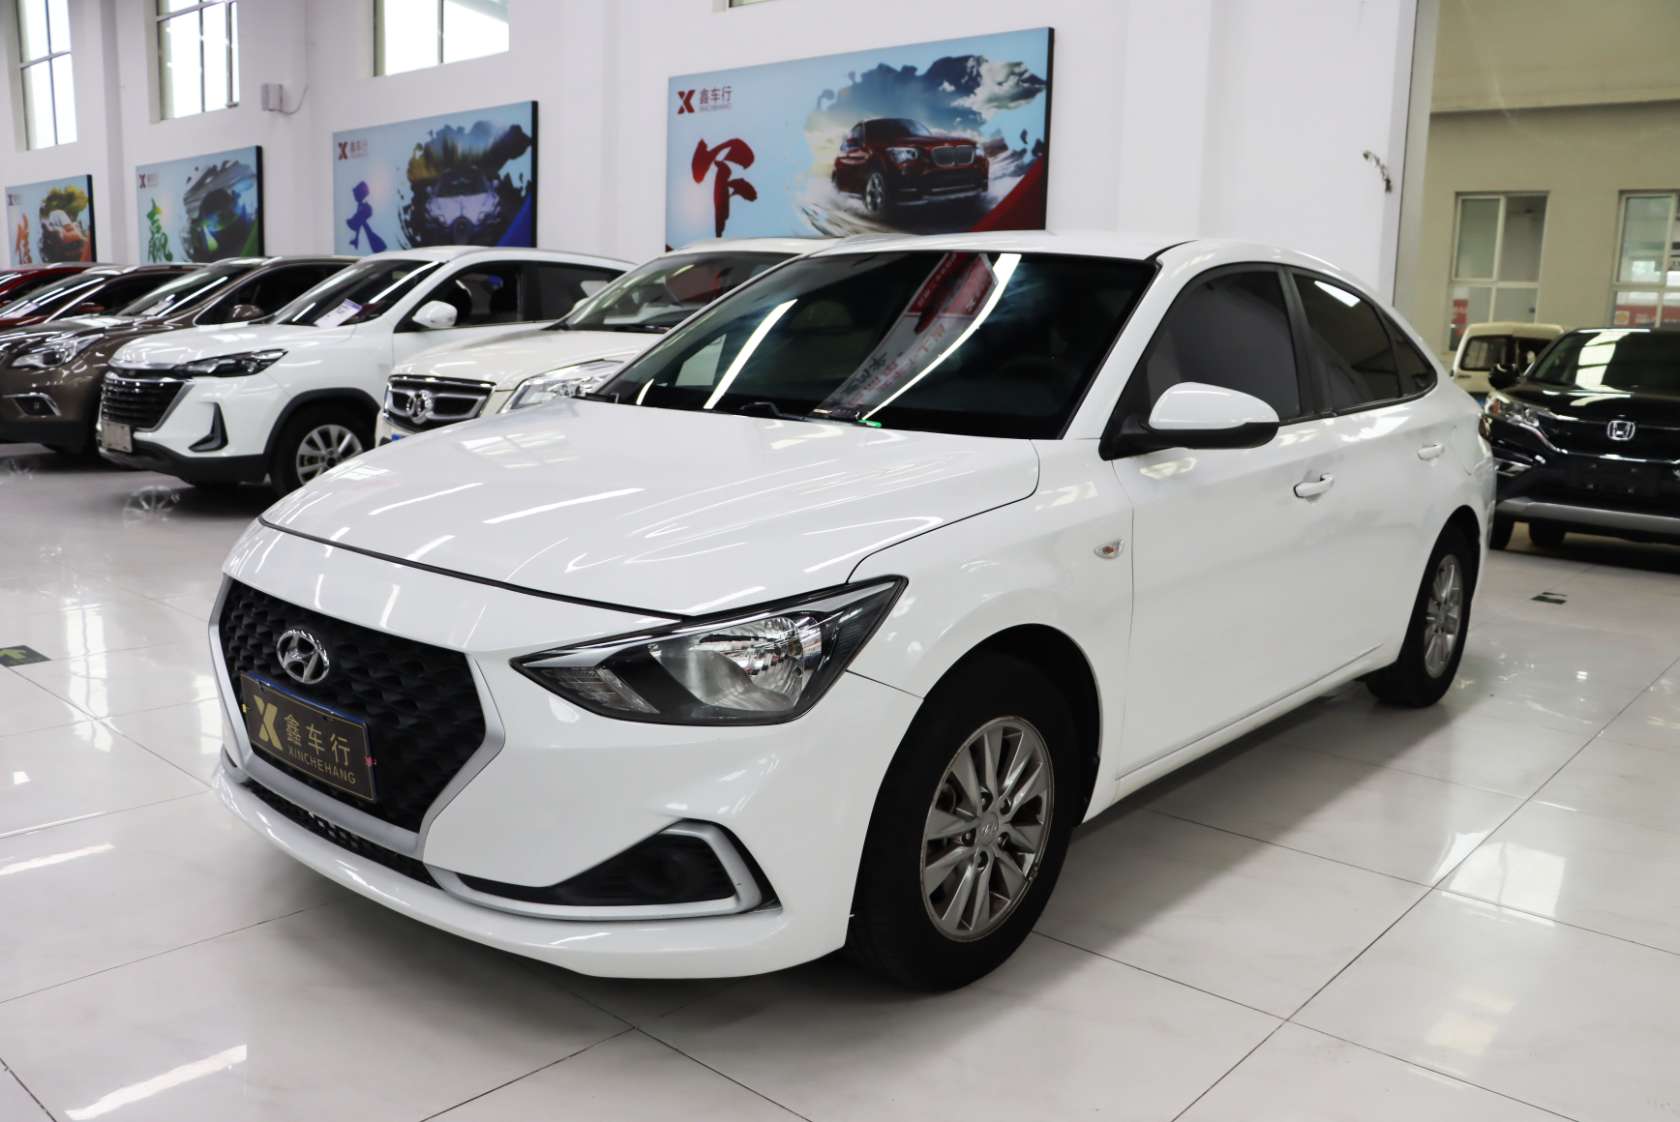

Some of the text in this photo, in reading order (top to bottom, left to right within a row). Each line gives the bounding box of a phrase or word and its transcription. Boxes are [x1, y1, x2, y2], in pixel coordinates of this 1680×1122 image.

[284, 713, 351, 767] 鑫车行
[288, 745, 357, 784] XINCHEHANG
